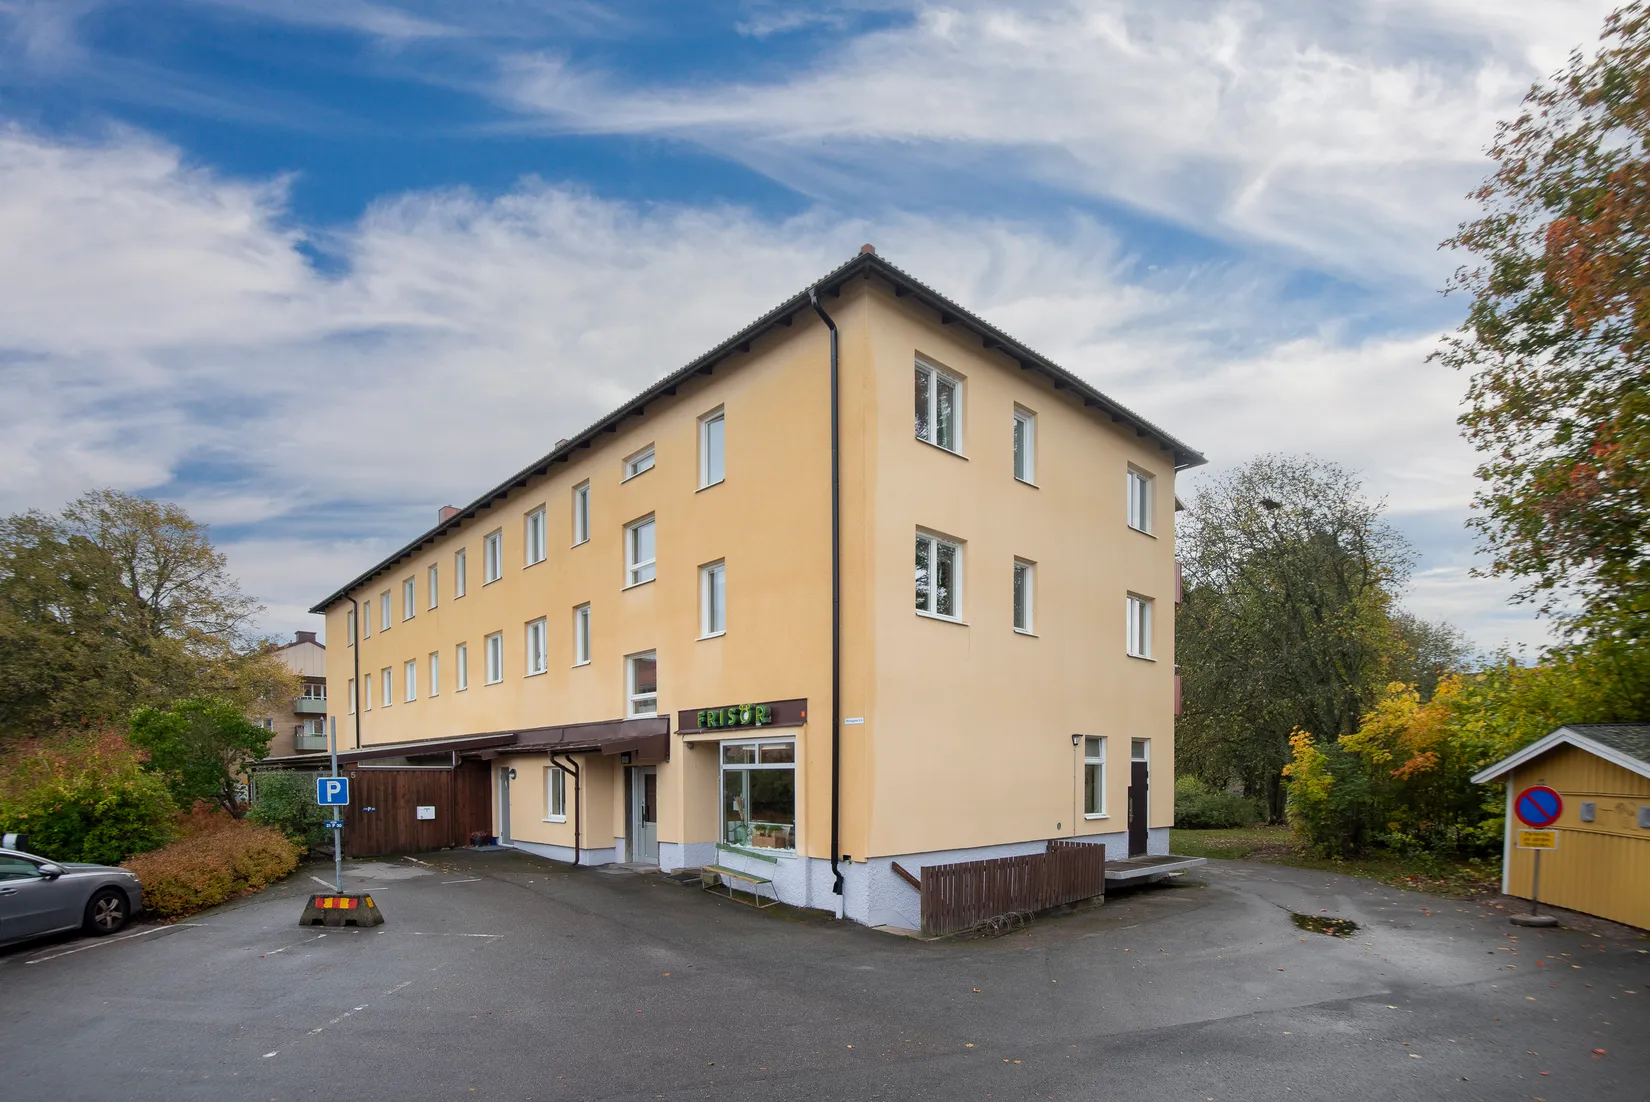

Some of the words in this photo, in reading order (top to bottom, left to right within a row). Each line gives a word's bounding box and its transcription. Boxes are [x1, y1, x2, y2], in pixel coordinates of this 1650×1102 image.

[697, 703, 769, 728] FRISÖR
[350, 771, 356, 779] 5
[326, 780, 341, 803] P
